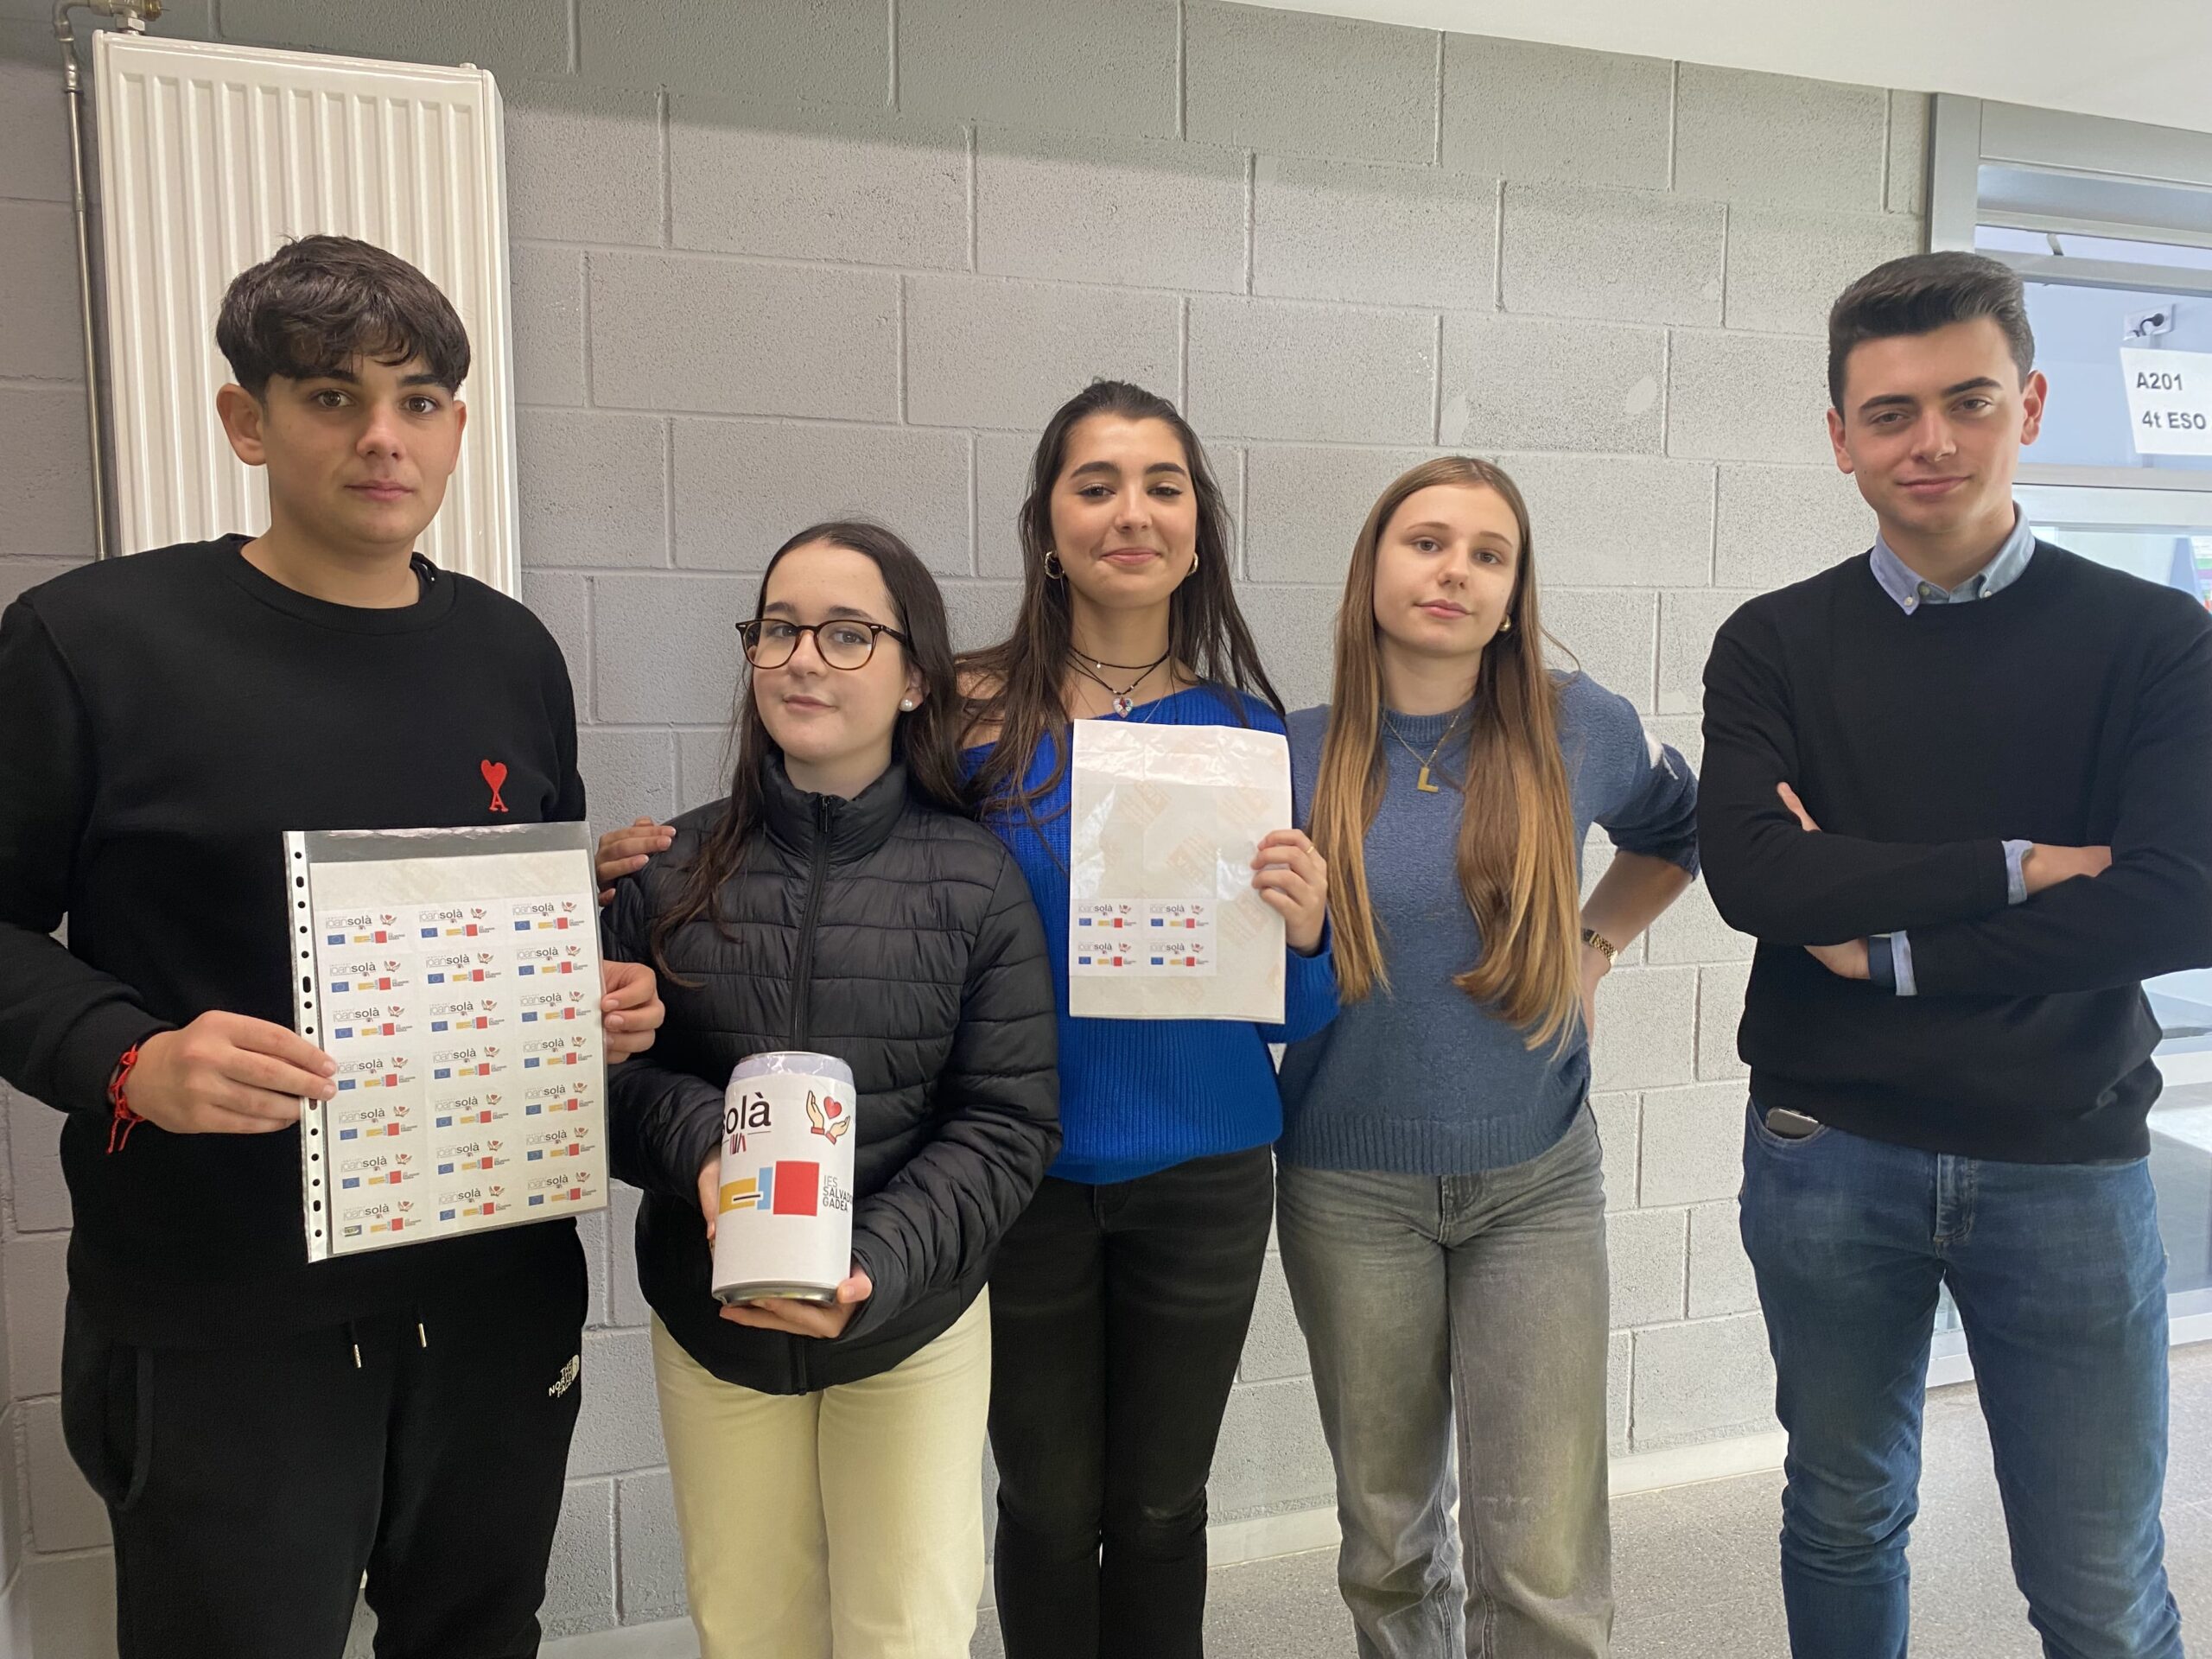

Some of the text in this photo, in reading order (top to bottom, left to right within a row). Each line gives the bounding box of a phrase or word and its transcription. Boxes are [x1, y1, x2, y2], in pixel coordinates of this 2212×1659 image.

[2137, 372, 2183, 391] A201
[2142, 410, 2206, 429] 4t ESO
[723, 1091, 772, 1134] olà
[823, 1175, 838, 1187] IES
[823, 1197, 849, 1212] GADEA
